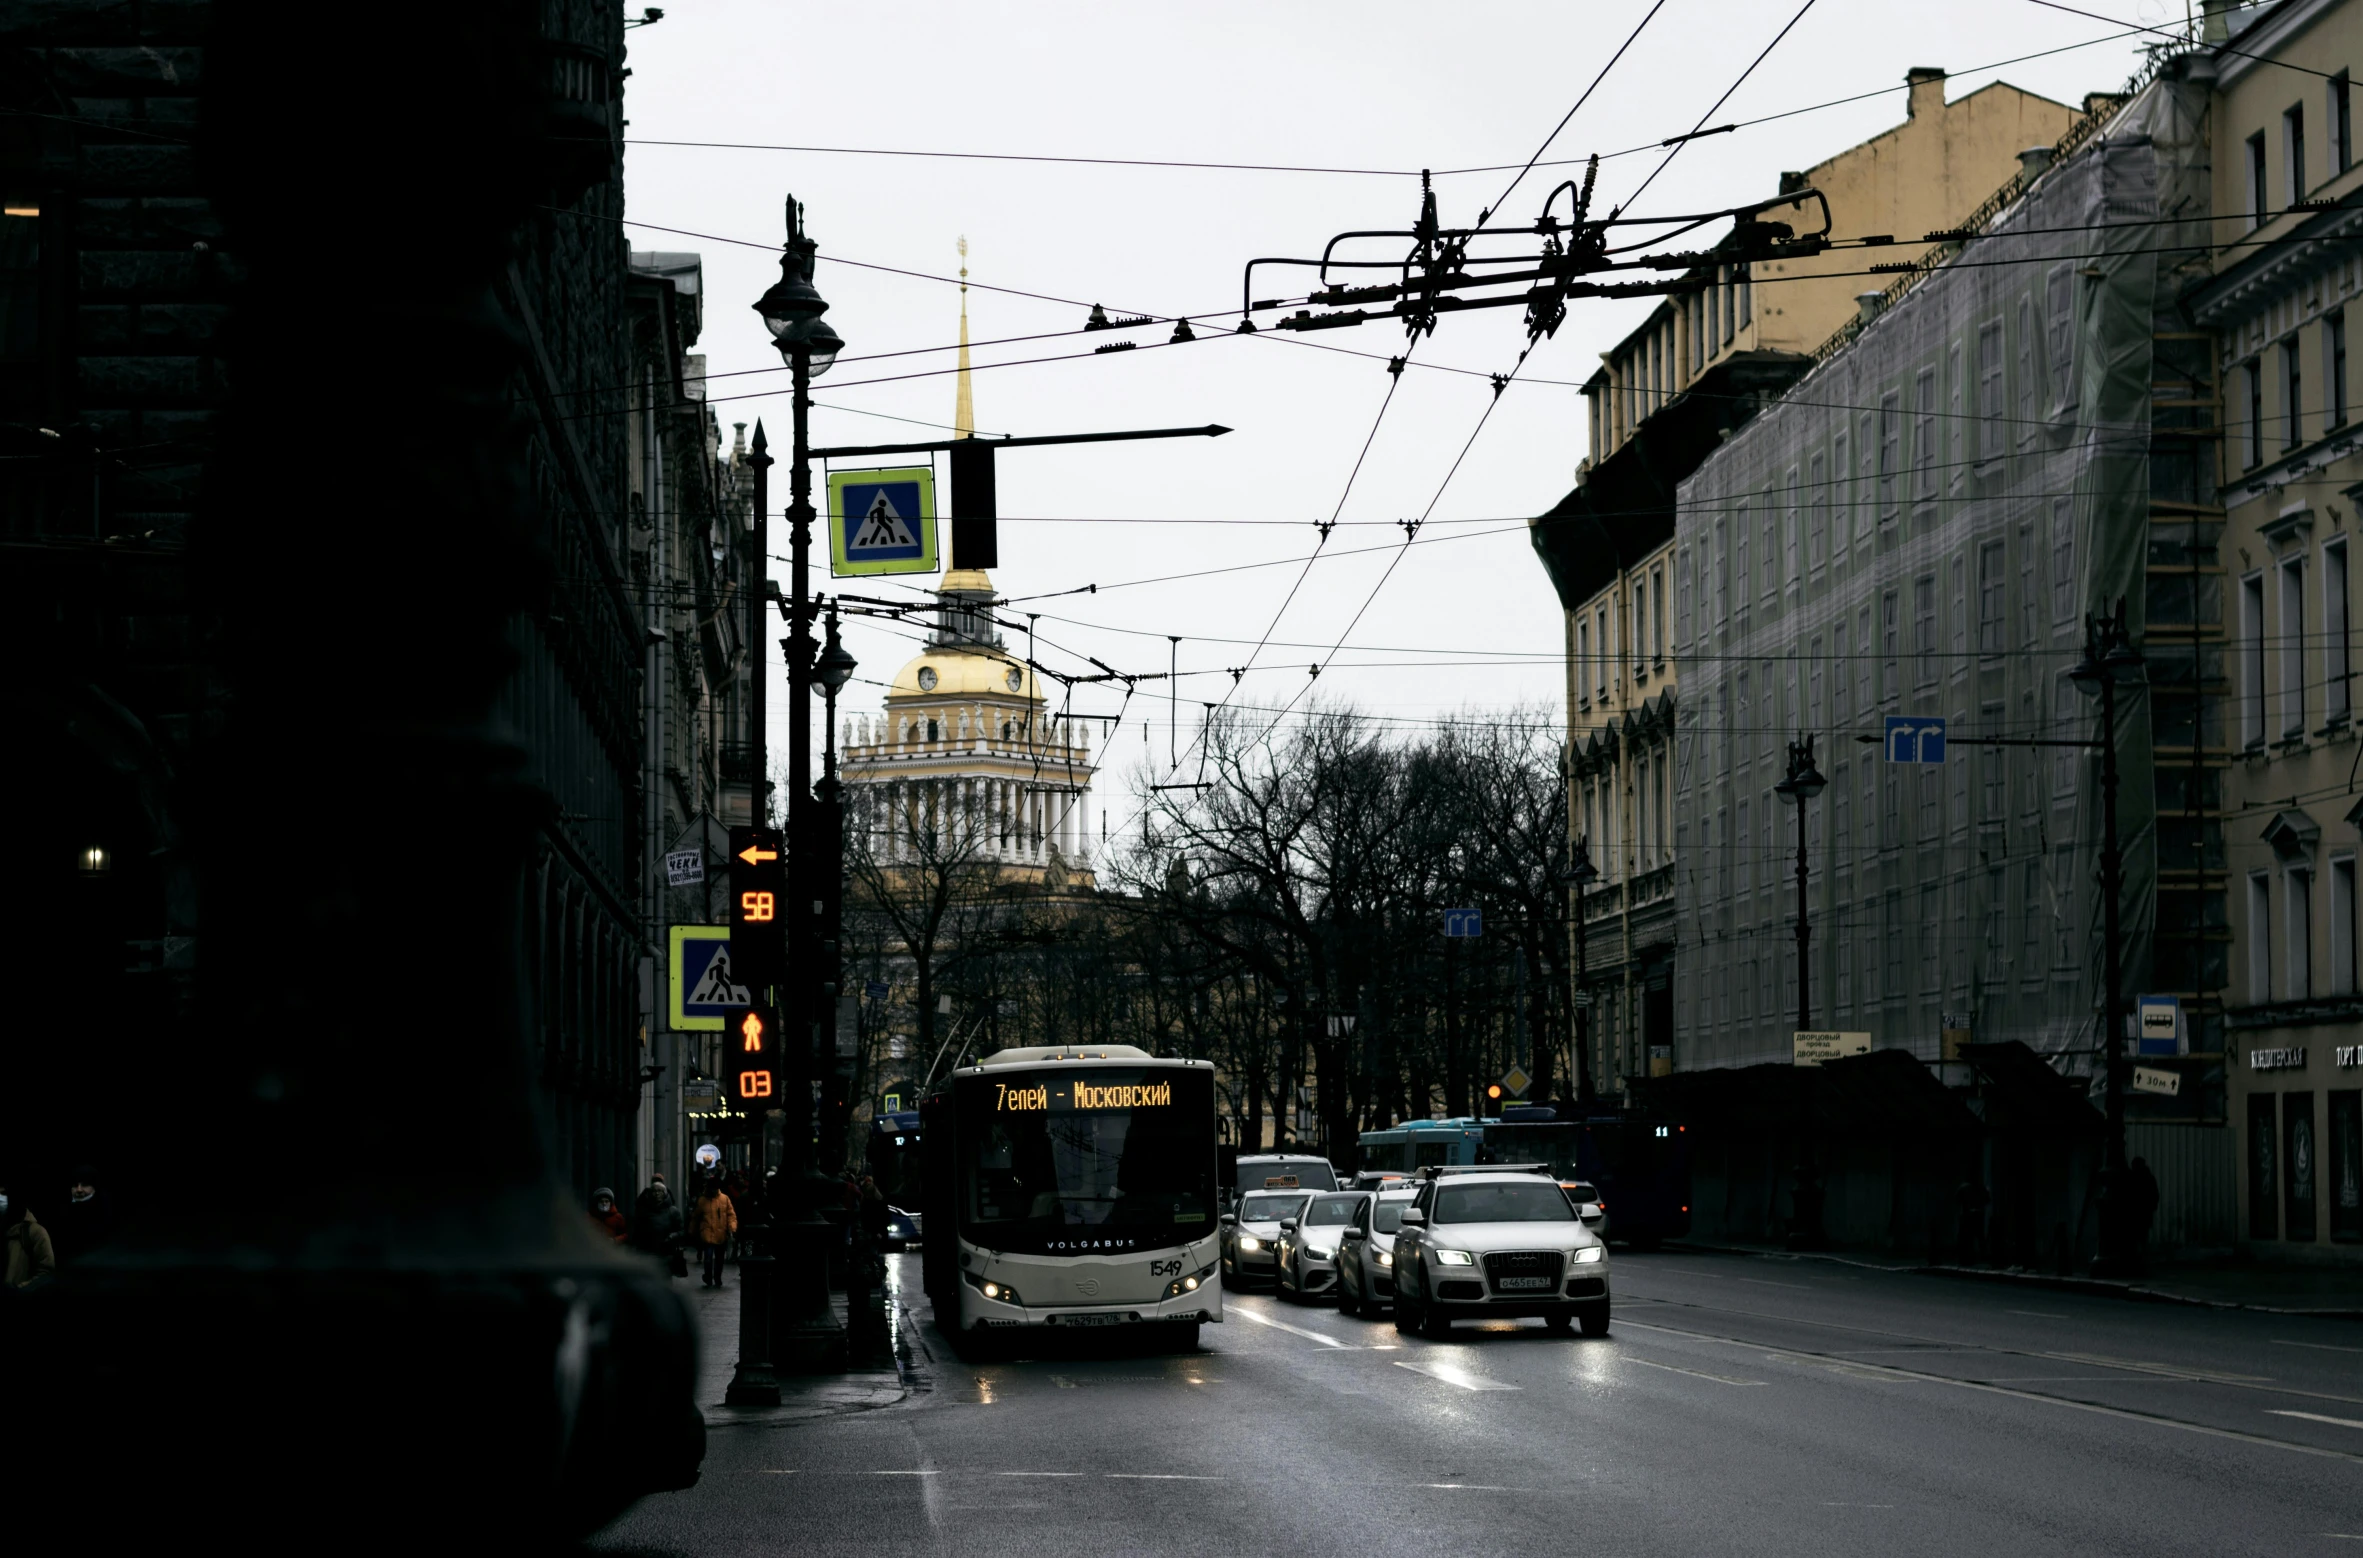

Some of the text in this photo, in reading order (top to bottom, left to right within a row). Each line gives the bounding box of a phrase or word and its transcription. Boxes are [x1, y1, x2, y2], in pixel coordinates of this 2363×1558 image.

[670, 857, 699, 870] ЧЕКИ
[742, 892, 774, 920] 58
[1796, 1033, 1841, 1041] ДВОРЦОВЫЙ
[1796, 1050, 1841, 1058] ДВОРЦОВЫЙ
[2251, 1047, 2303, 1070] КОНДИТЕРСКАЯ
[2336, 1046, 2355, 1067] ТОРТ
[740, 1071, 772, 1097] 03
[1074, 1080, 1171, 1109] Московский
[1655, 1125, 1668, 1137] 11
[1047, 1239, 1136, 1250] VOLGABUS
[1150, 1260, 1182, 1277] 1549
